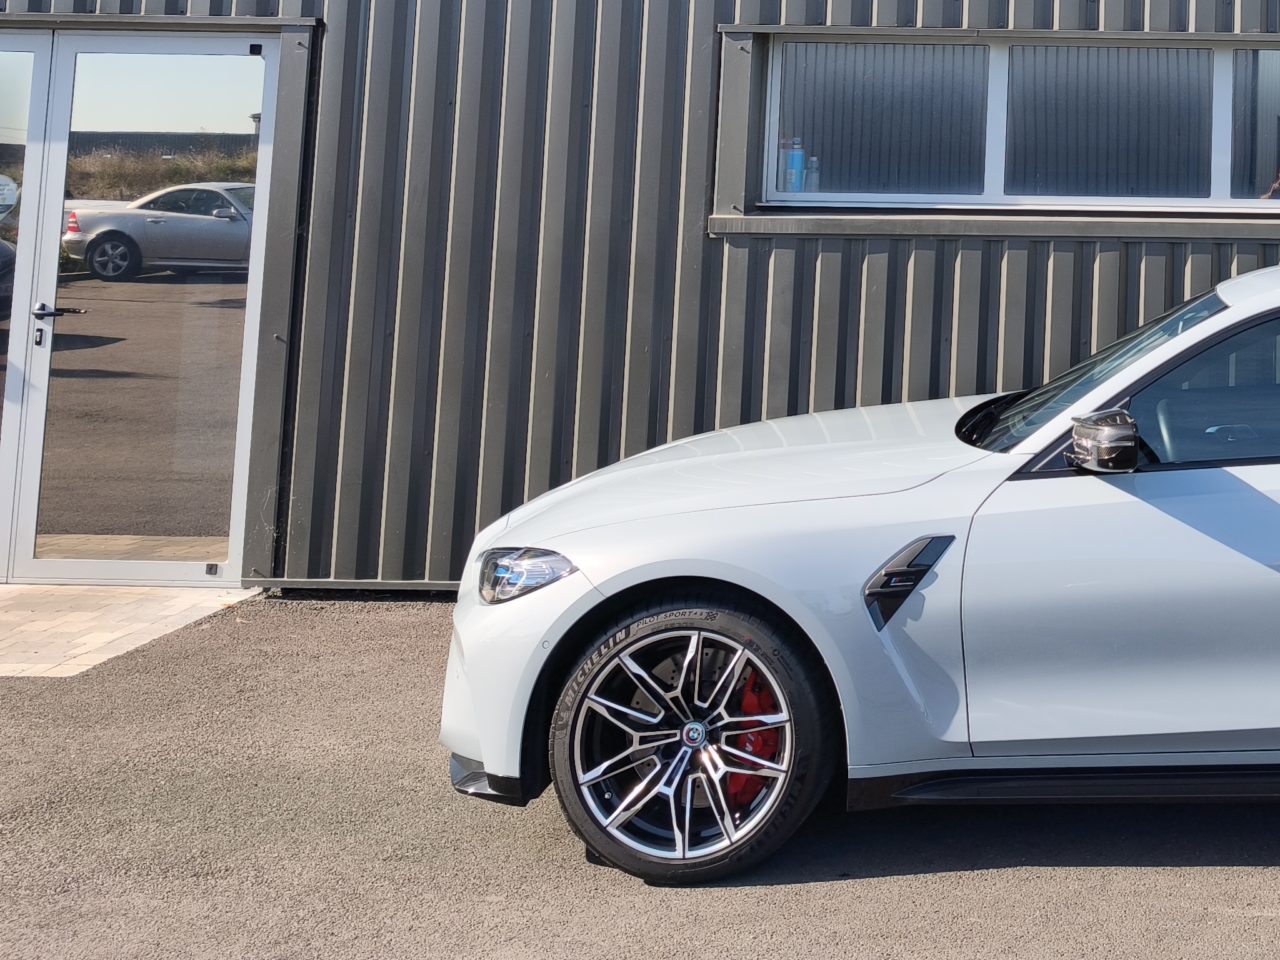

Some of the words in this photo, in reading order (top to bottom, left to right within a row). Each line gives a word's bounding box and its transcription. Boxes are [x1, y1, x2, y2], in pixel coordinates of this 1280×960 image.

[636, 615, 660, 628] PILOT
[663, 611, 693, 620] SPORT
[564, 628, 627, 707] MICHELIN
